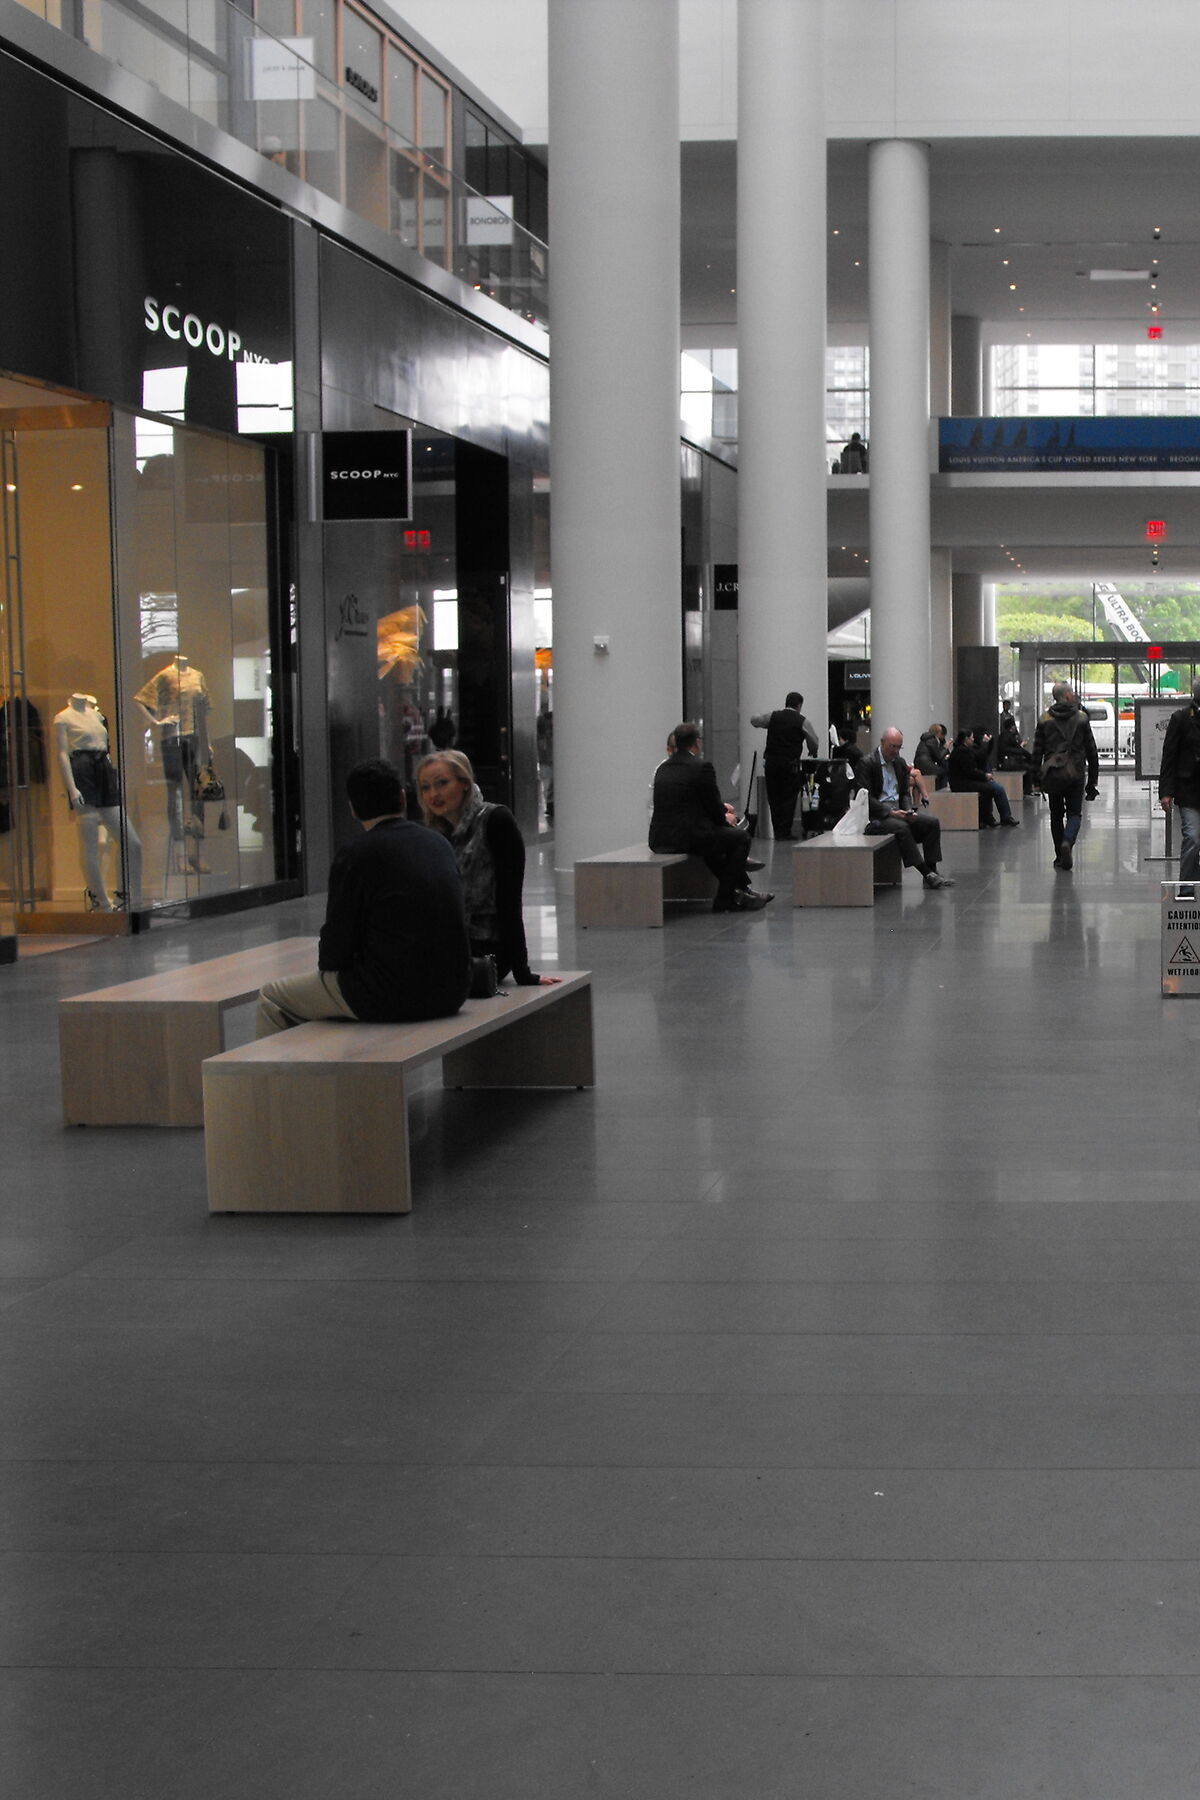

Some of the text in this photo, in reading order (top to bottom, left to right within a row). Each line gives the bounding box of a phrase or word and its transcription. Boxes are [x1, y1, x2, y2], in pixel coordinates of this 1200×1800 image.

[143, 295, 242, 362] SCOOP
[949, 455, 971, 464] LOUIS
[1007, 455, 1046, 464] AMERICA'S
[1047, 455, 1063, 464] CUP
[1065, 455, 1092, 464] WORLD
[1093, 455, 1117, 464] SERIES
[1118, 455, 1137, 464] NEW
[1138, 455, 1158, 464] YORK
[330, 469, 381, 480] SCOOP
[1107, 595, 1129, 624] ULTRA
[1167, 968, 1181, 976] WET
